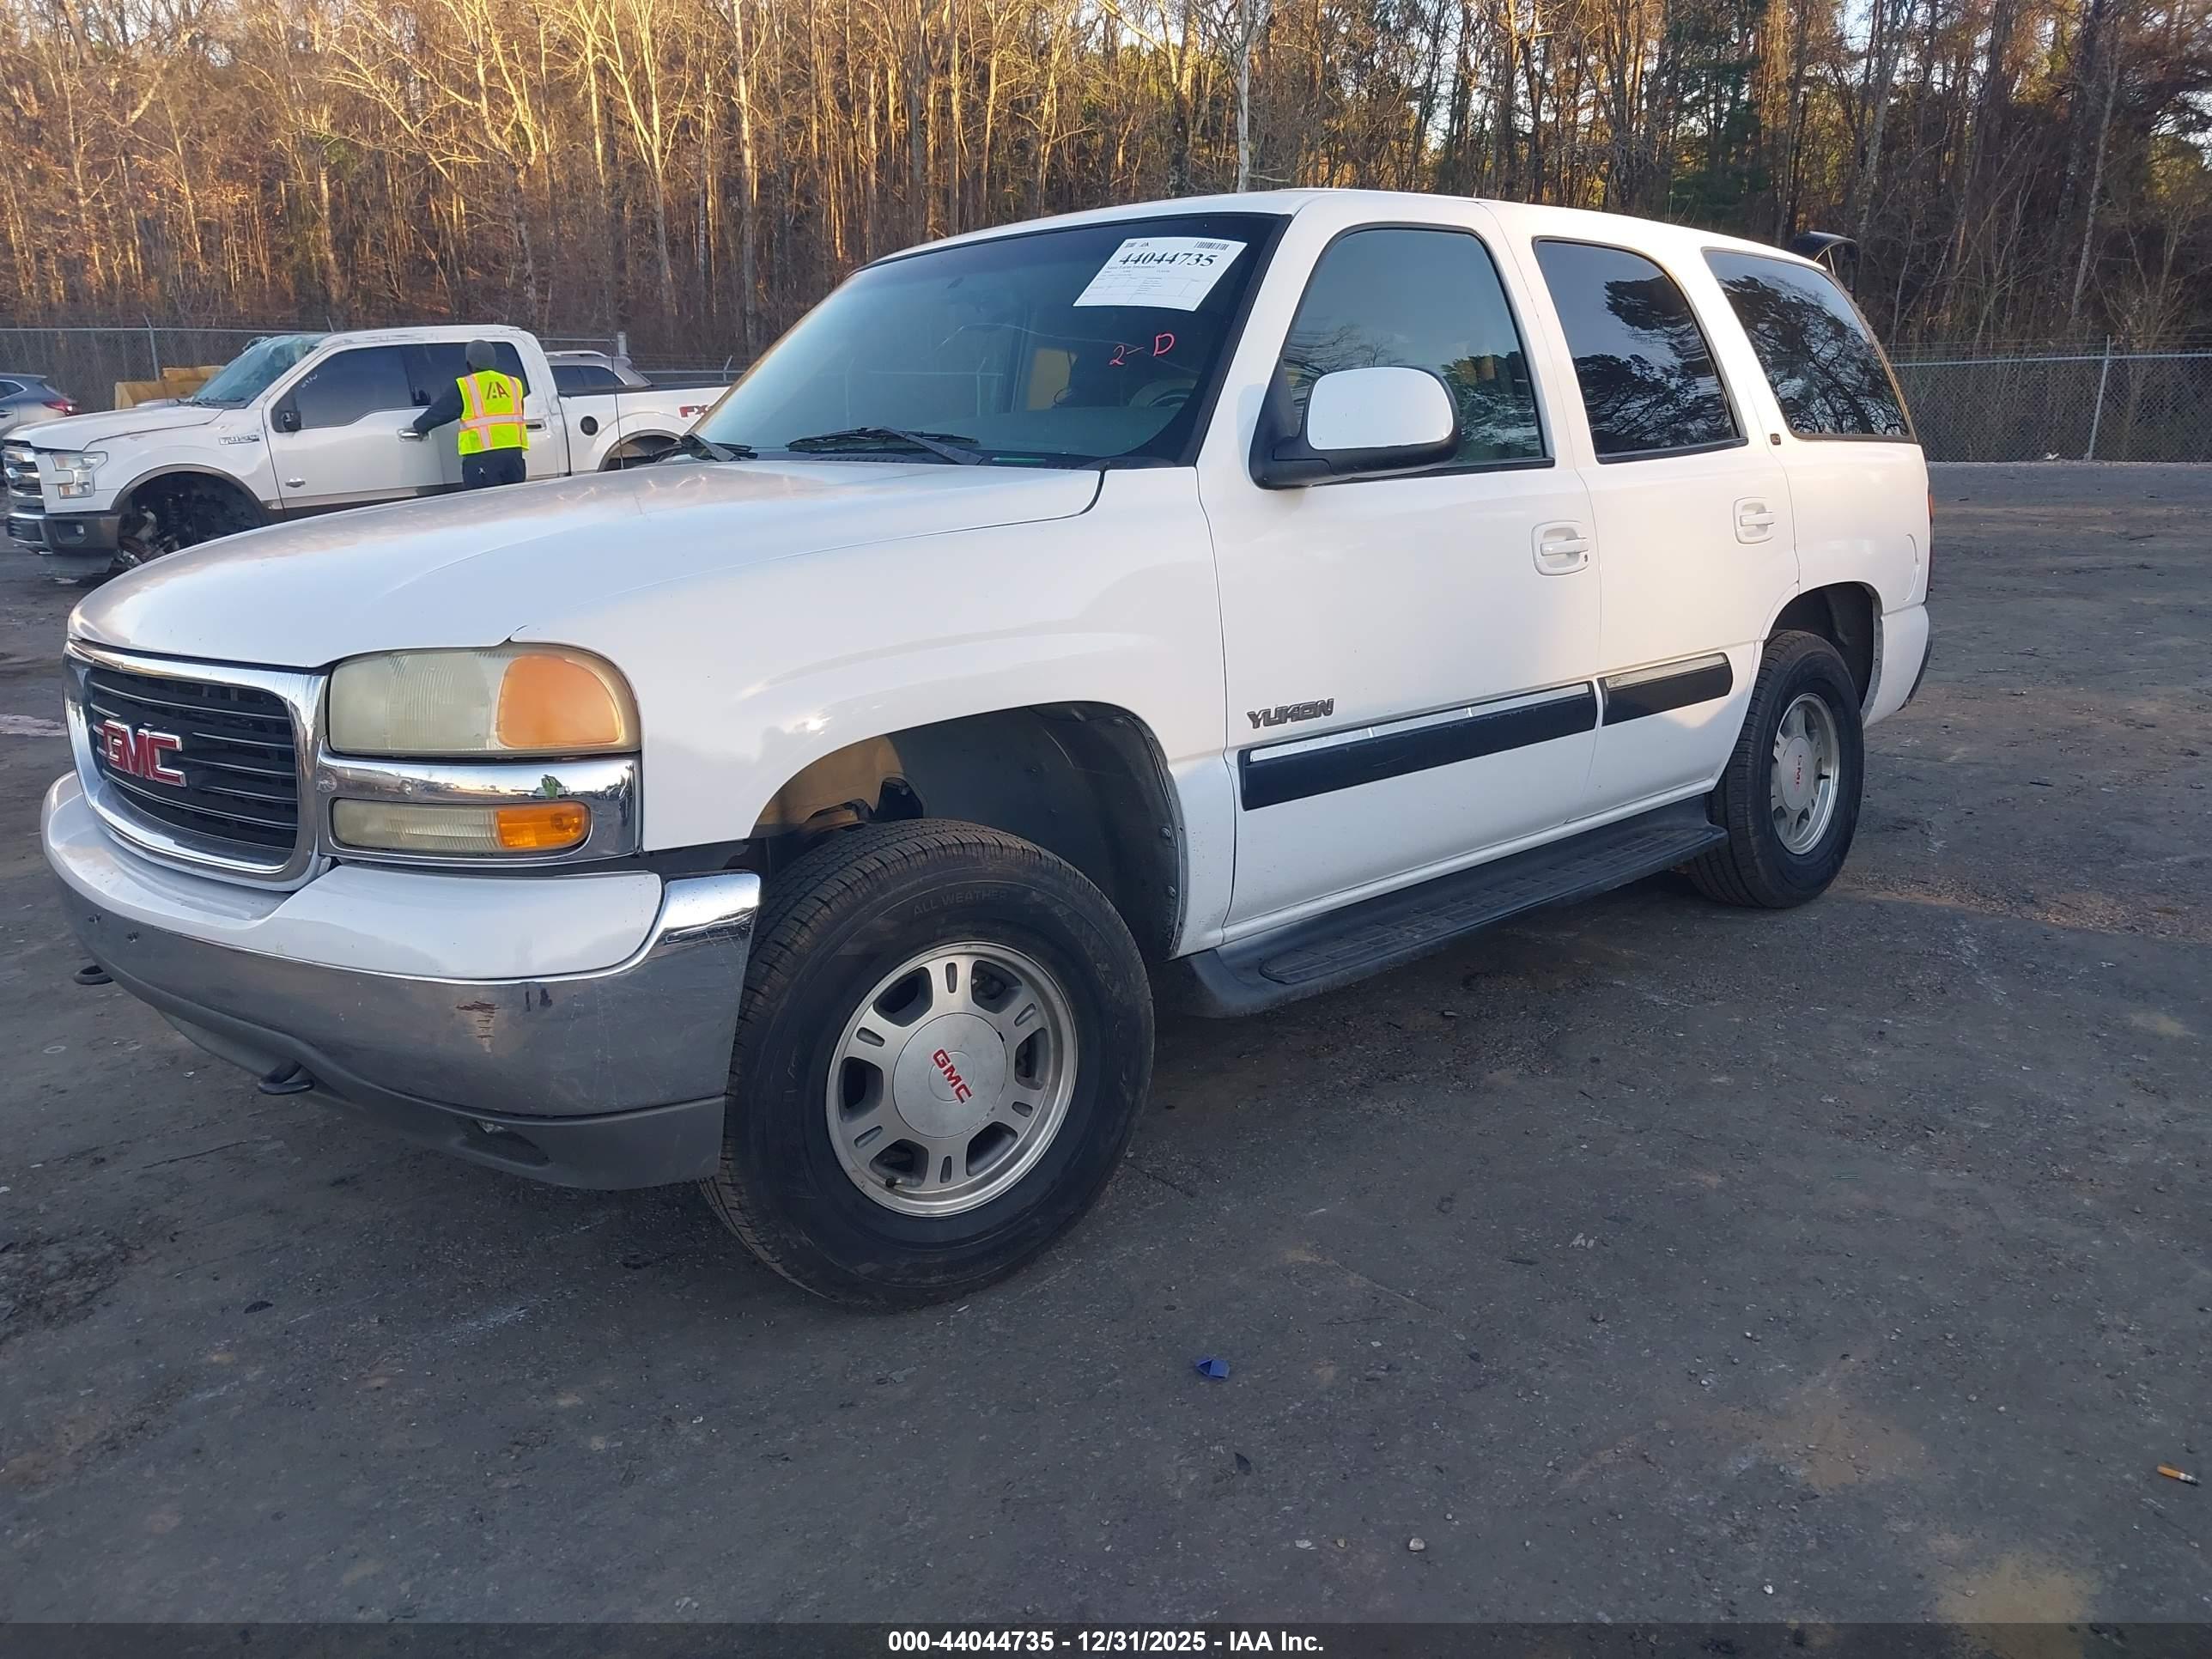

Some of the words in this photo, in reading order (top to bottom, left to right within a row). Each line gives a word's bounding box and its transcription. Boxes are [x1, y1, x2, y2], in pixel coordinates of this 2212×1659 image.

[1118, 252, 1218, 266] 44044735
[1247, 698, 1334, 729] YUKON
[102, 720, 186, 787] GMC
[913, 900, 939, 918] ALL
[941, 889, 1010, 907] WEATHER
[933, 1048, 972, 1104] GMC
